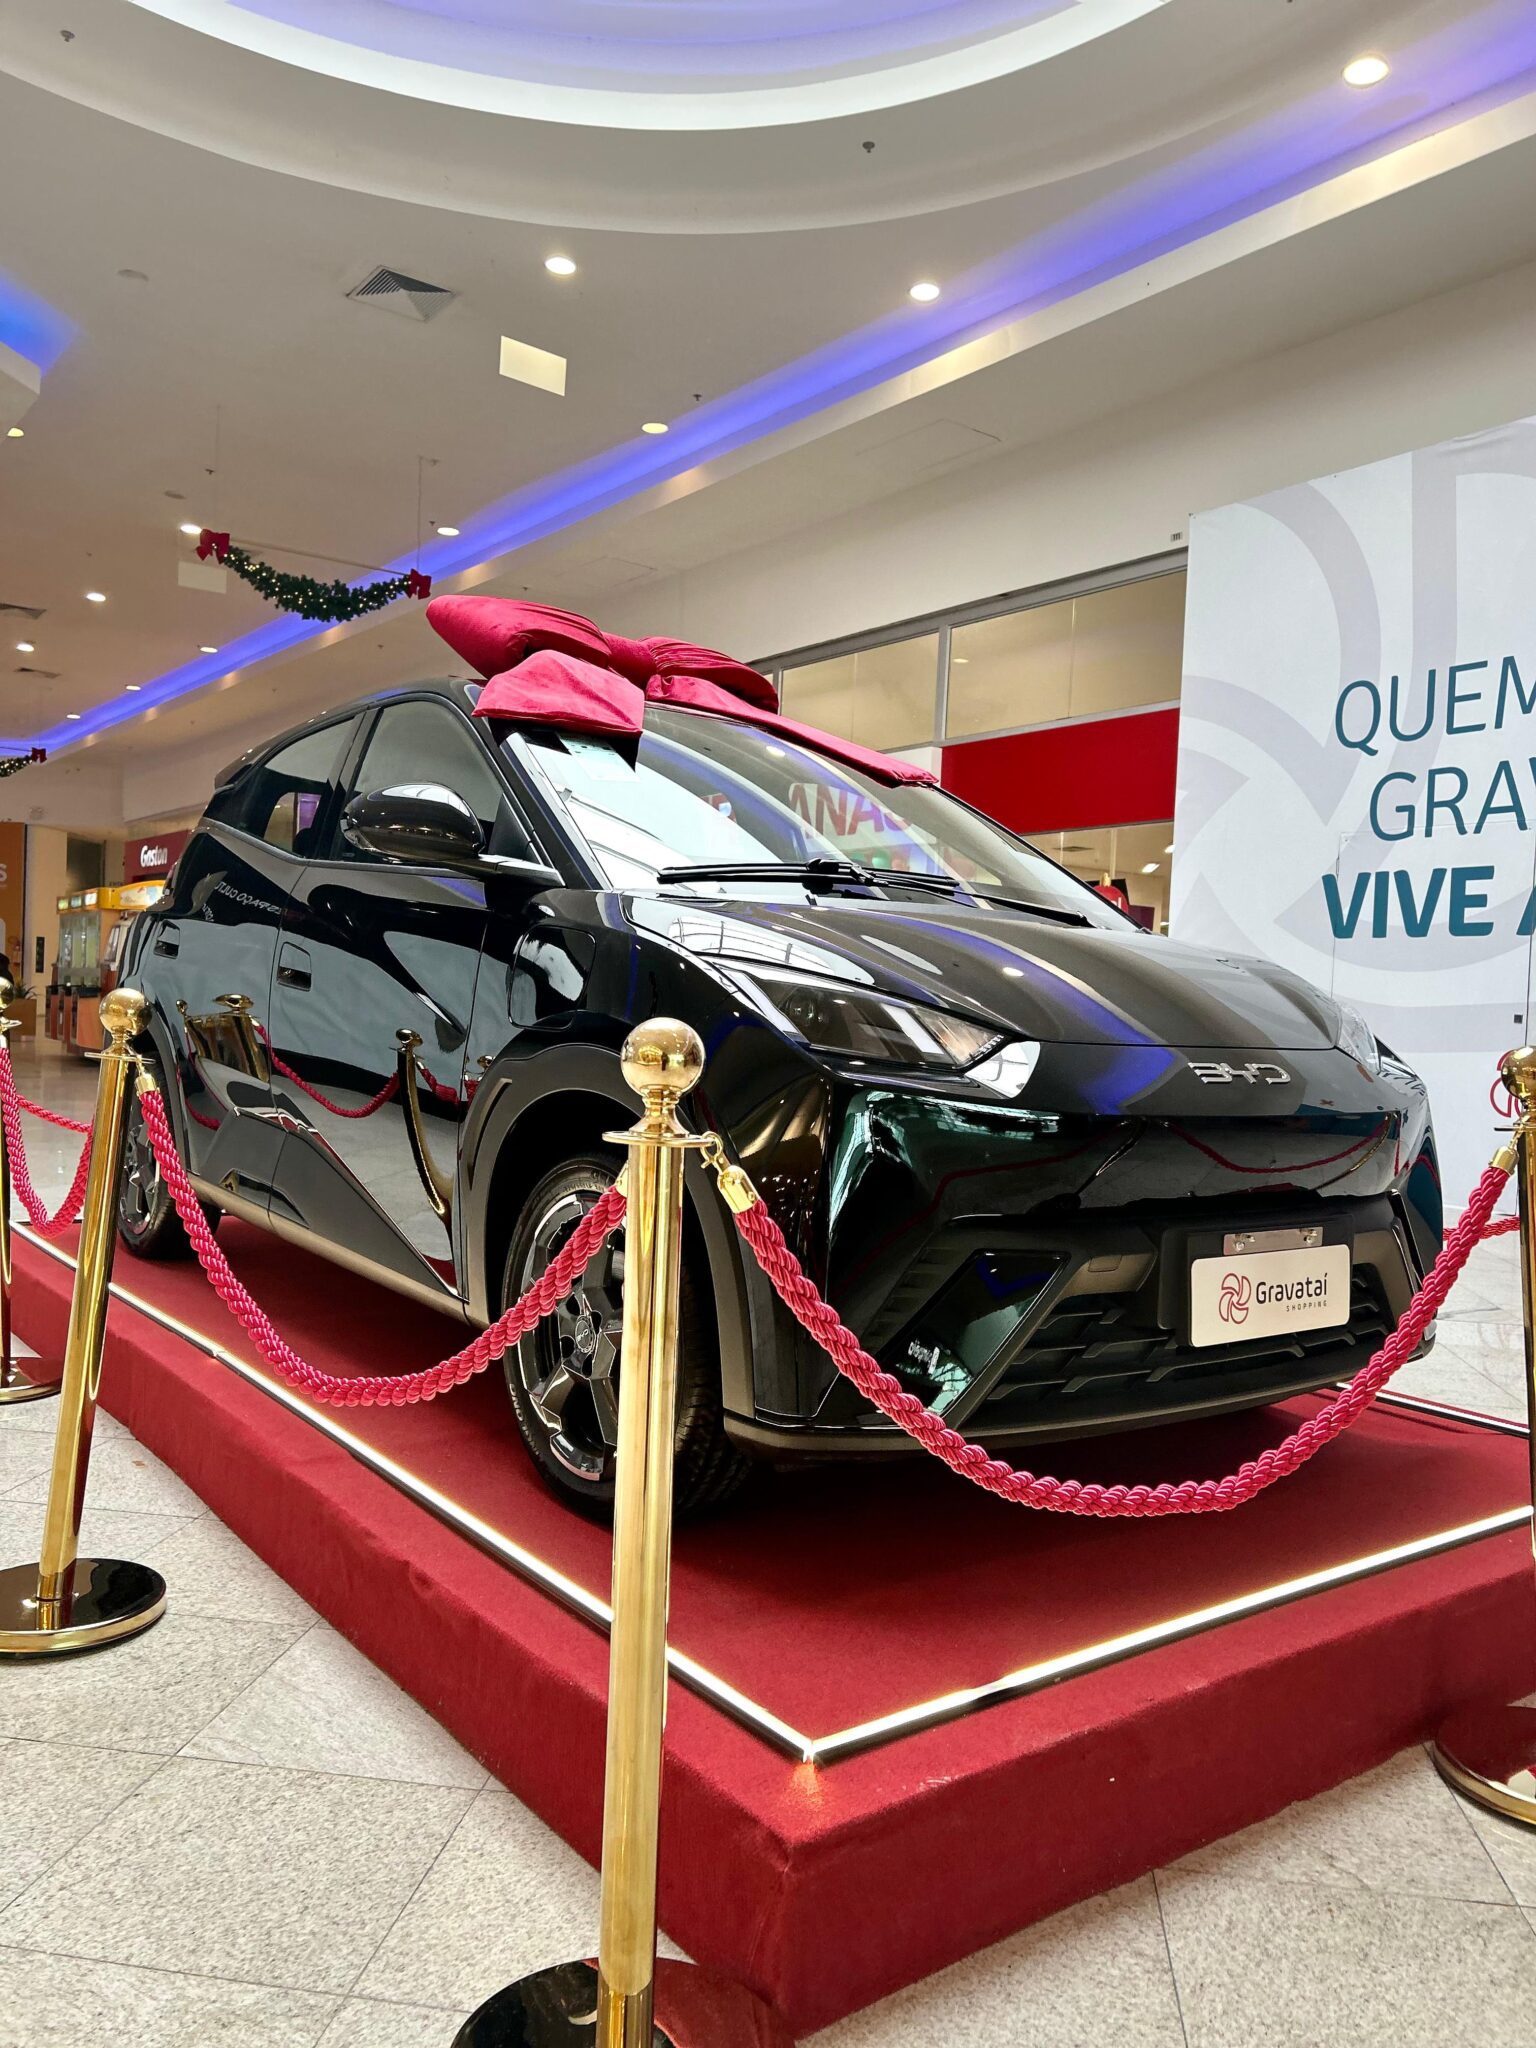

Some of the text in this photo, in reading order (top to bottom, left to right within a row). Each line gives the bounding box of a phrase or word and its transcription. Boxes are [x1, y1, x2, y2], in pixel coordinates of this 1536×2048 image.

[1335, 655, 1536, 756] QUEM
[1369, 757, 1536, 841] GRA
[140, 844, 168, 867] Gaston
[1321, 865, 1495, 939] VIVE
[1187, 1062, 1292, 1084] BYD
[1256, 1272, 1328, 1304] Gravataí
[1286, 1300, 1328, 1312] SHOPPING
